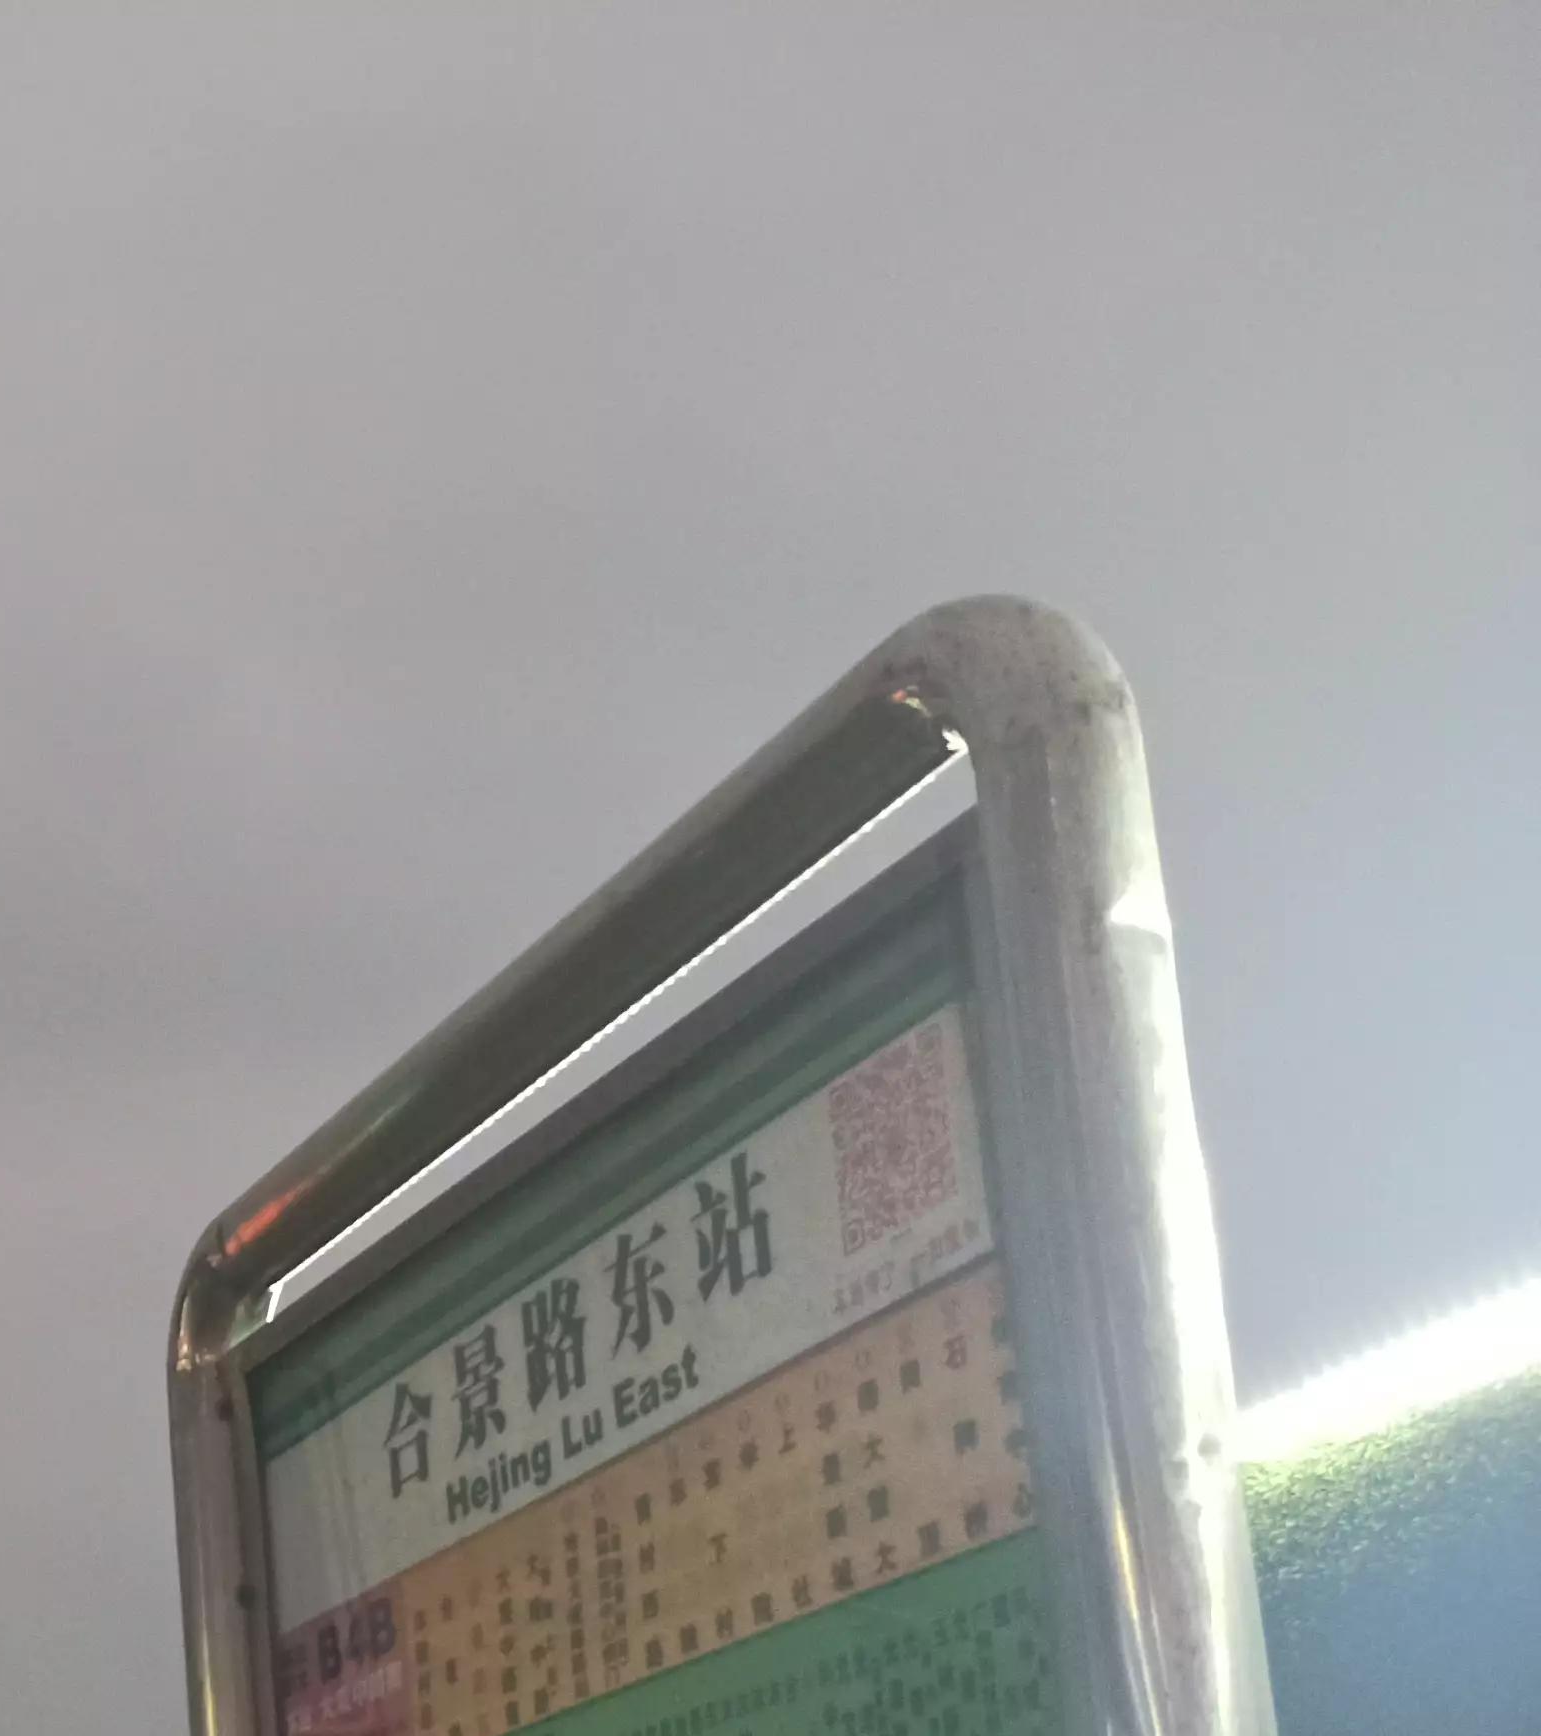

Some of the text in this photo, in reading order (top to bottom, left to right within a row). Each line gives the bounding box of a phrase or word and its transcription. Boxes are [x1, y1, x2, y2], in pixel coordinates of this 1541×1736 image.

[383, 1152, 774, 1499] 合景路东站
[445, 1342, 701, 1525] Hejing Lu East
